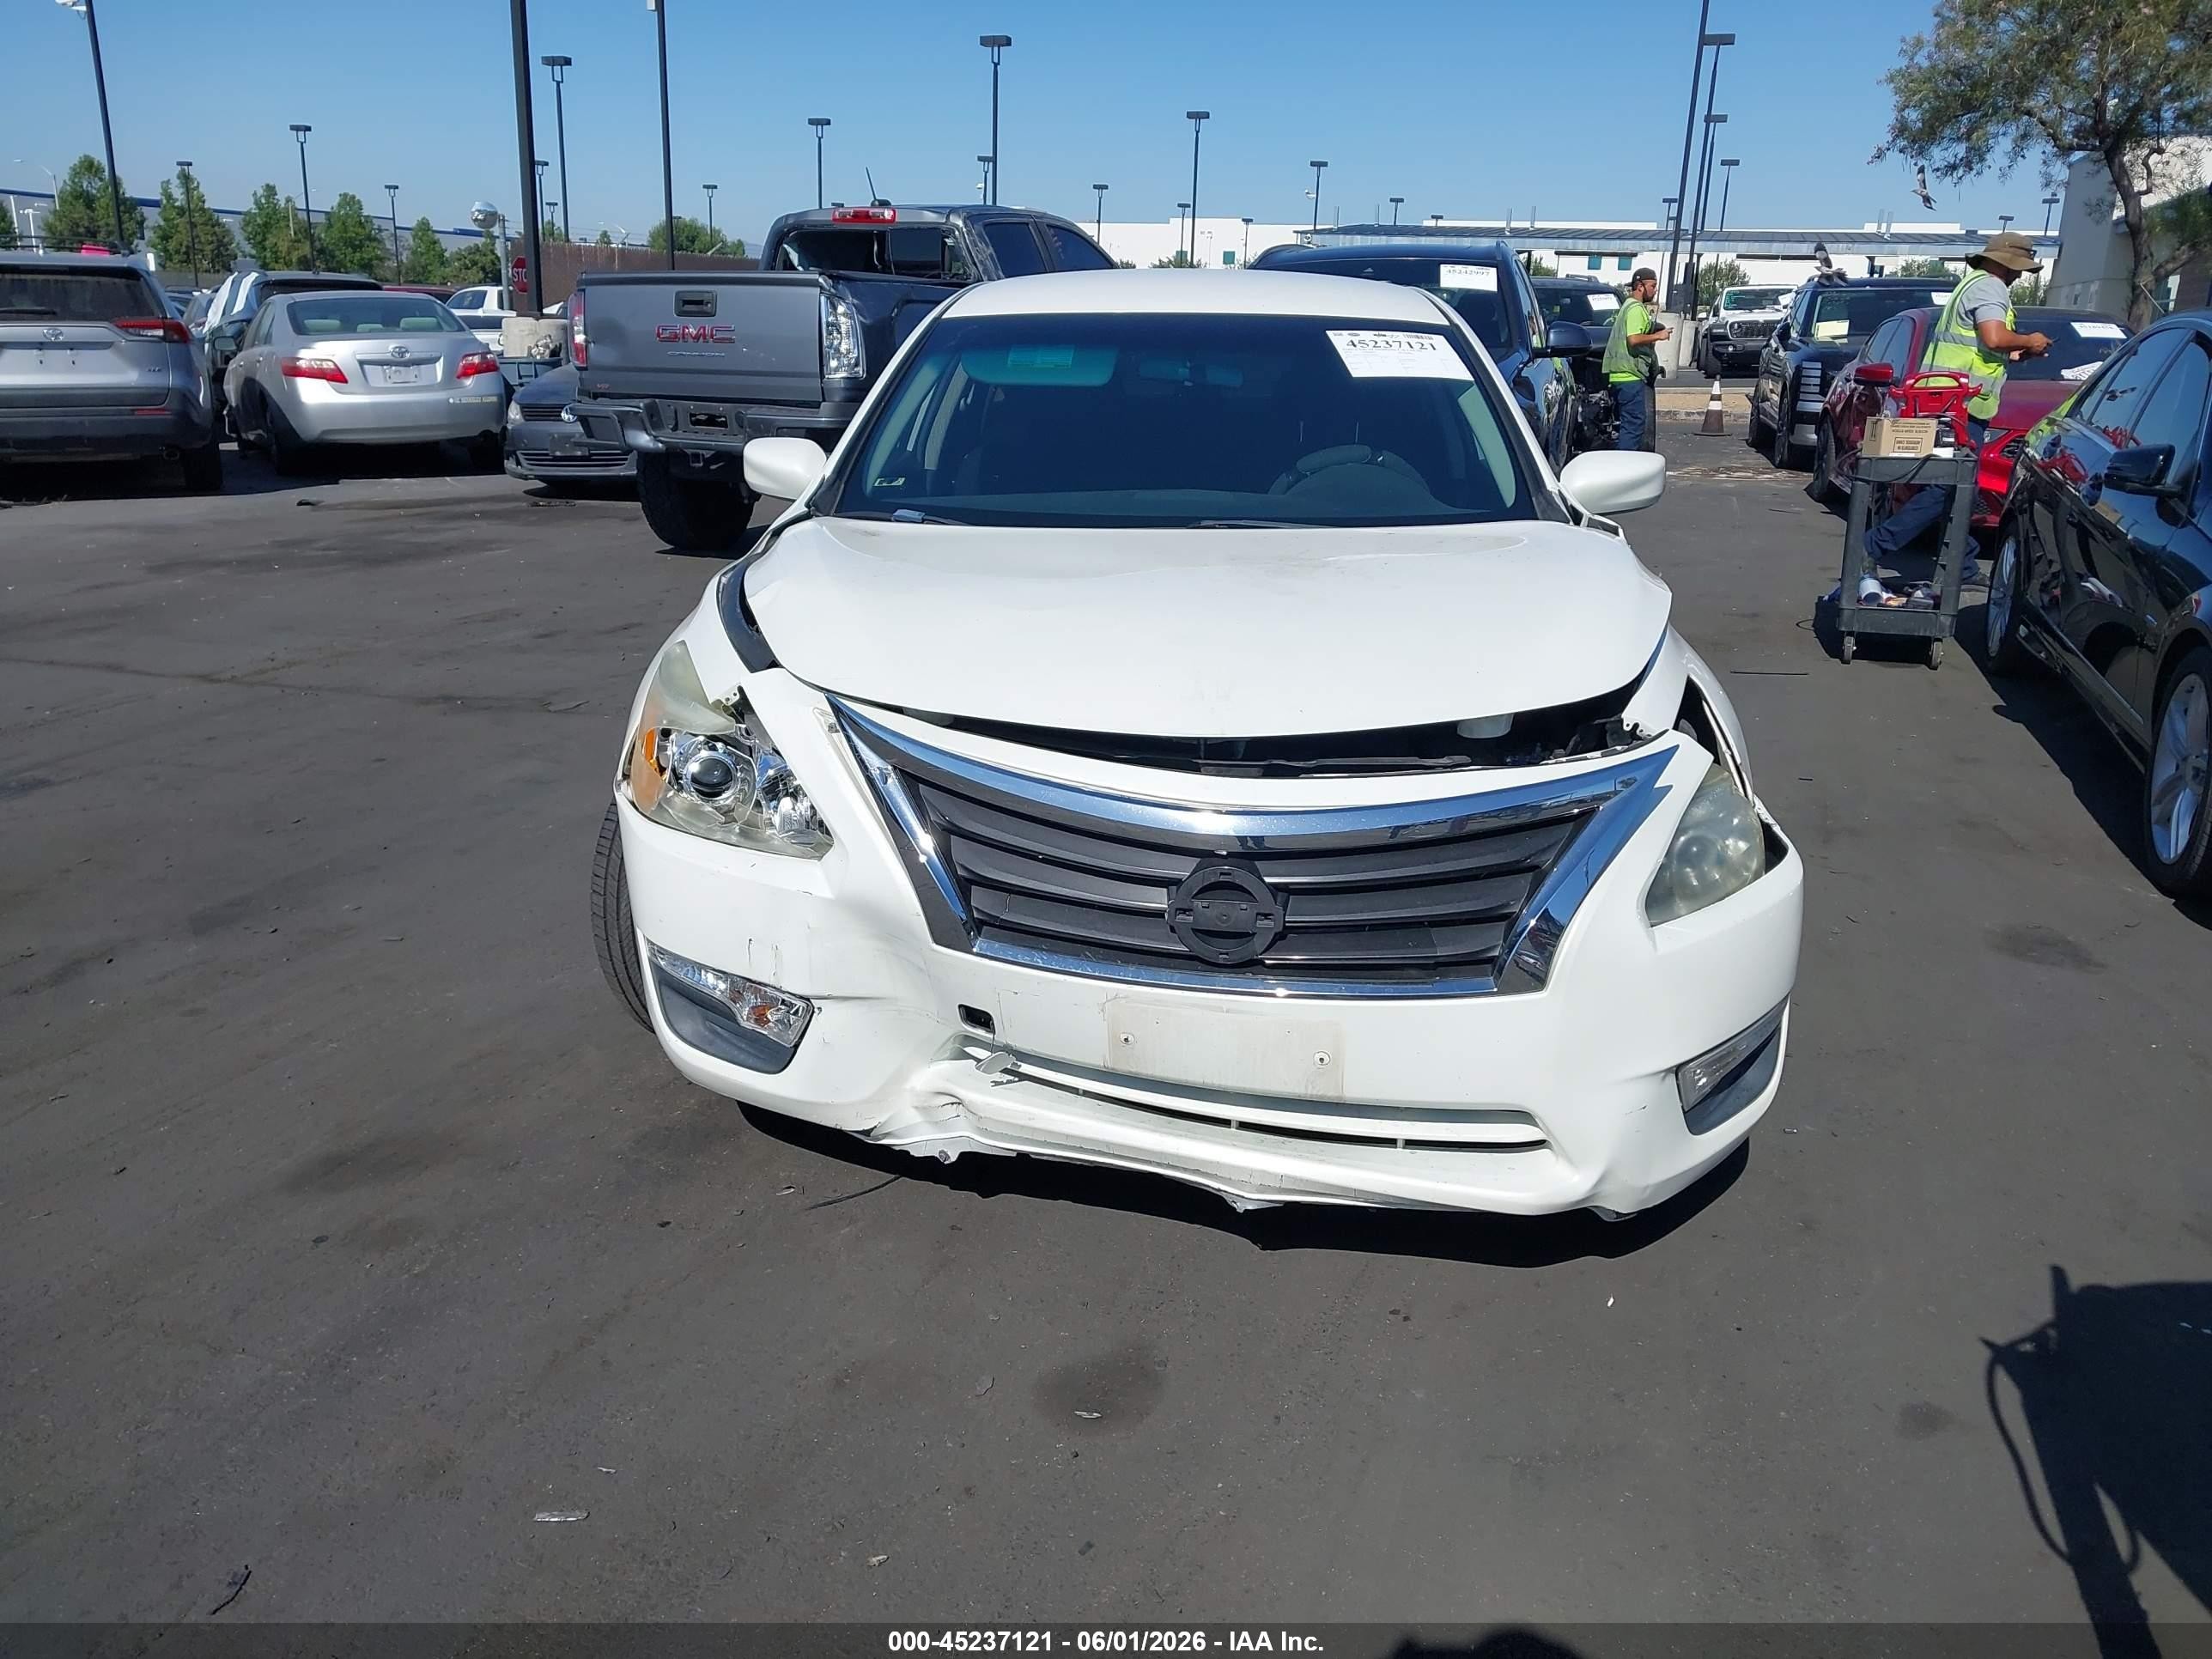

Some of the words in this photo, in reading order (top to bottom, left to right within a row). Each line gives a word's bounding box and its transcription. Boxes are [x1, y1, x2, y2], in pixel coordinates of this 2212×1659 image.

[513, 267, 527, 283] STO
[655, 323, 736, 343] GMC
[1346, 338, 1437, 351] 45237121
